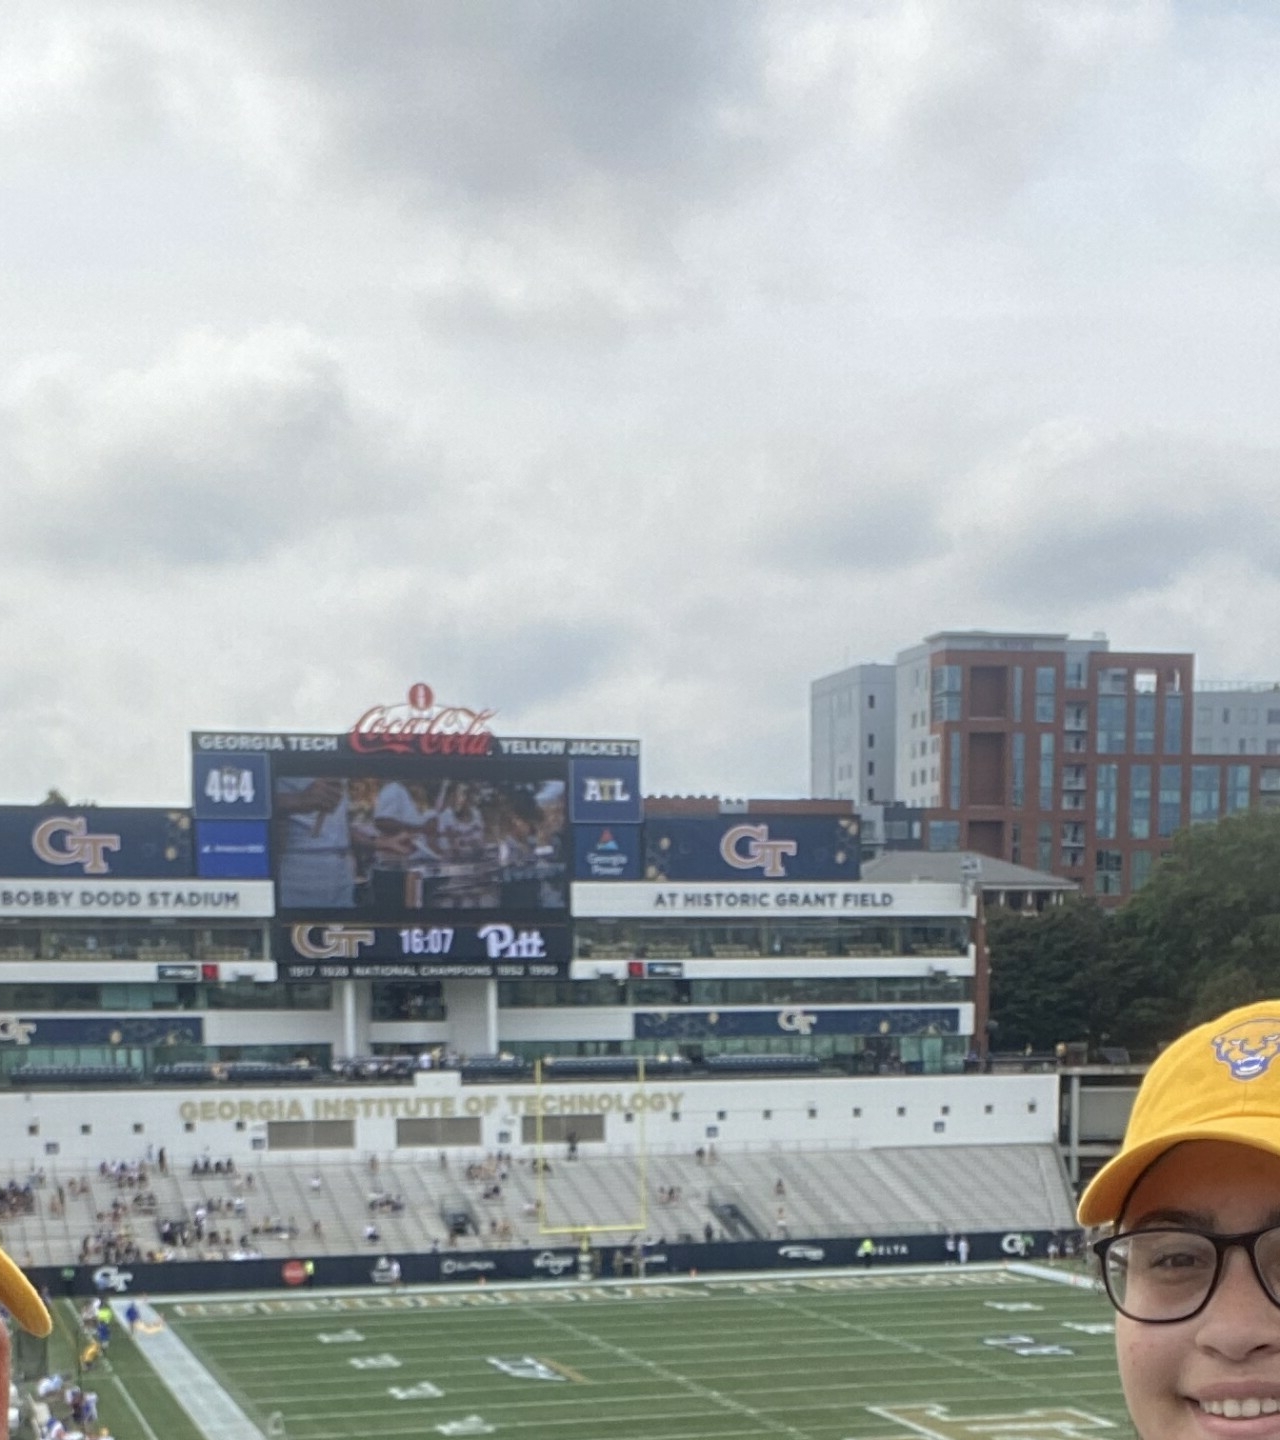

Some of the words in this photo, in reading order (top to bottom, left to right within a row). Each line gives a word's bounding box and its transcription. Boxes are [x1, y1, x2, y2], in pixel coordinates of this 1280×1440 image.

[198, 734, 285, 751] GEORGIA
[288, 736, 339, 752] TECH
[499, 740, 566, 755] YELLOW
[568, 741, 640, 757] JACKETS
[204, 768, 255, 803] 404
[583, 779, 631, 802] ATL
[32, 816, 120, 873] GT
[720, 824, 797, 877] GT
[1, 889, 72, 908] BOBBY
[80, 889, 141, 908] DODD
[148, 890, 240, 908] STADIUM
[654, 893, 678, 908] AT
[683, 893, 770, 908] HISTORIC
[776, 893, 838, 908] GRANT
[843, 893, 894, 908] FIELD
[291, 924, 375, 959] GT
[399, 929, 455, 954] 16:07
[476, 924, 547, 958] Pitt
[353, 965, 417, 977] NATIONAL
[420, 965, 493, 977] CHAMPIONS
[179, 1098, 303, 1121] GEORGIA
[313, 1096, 456, 1119] INSTITUTE
[466, 1095, 497, 1116] OF
[507, 1091, 685, 1117] TECHNOLOGY
